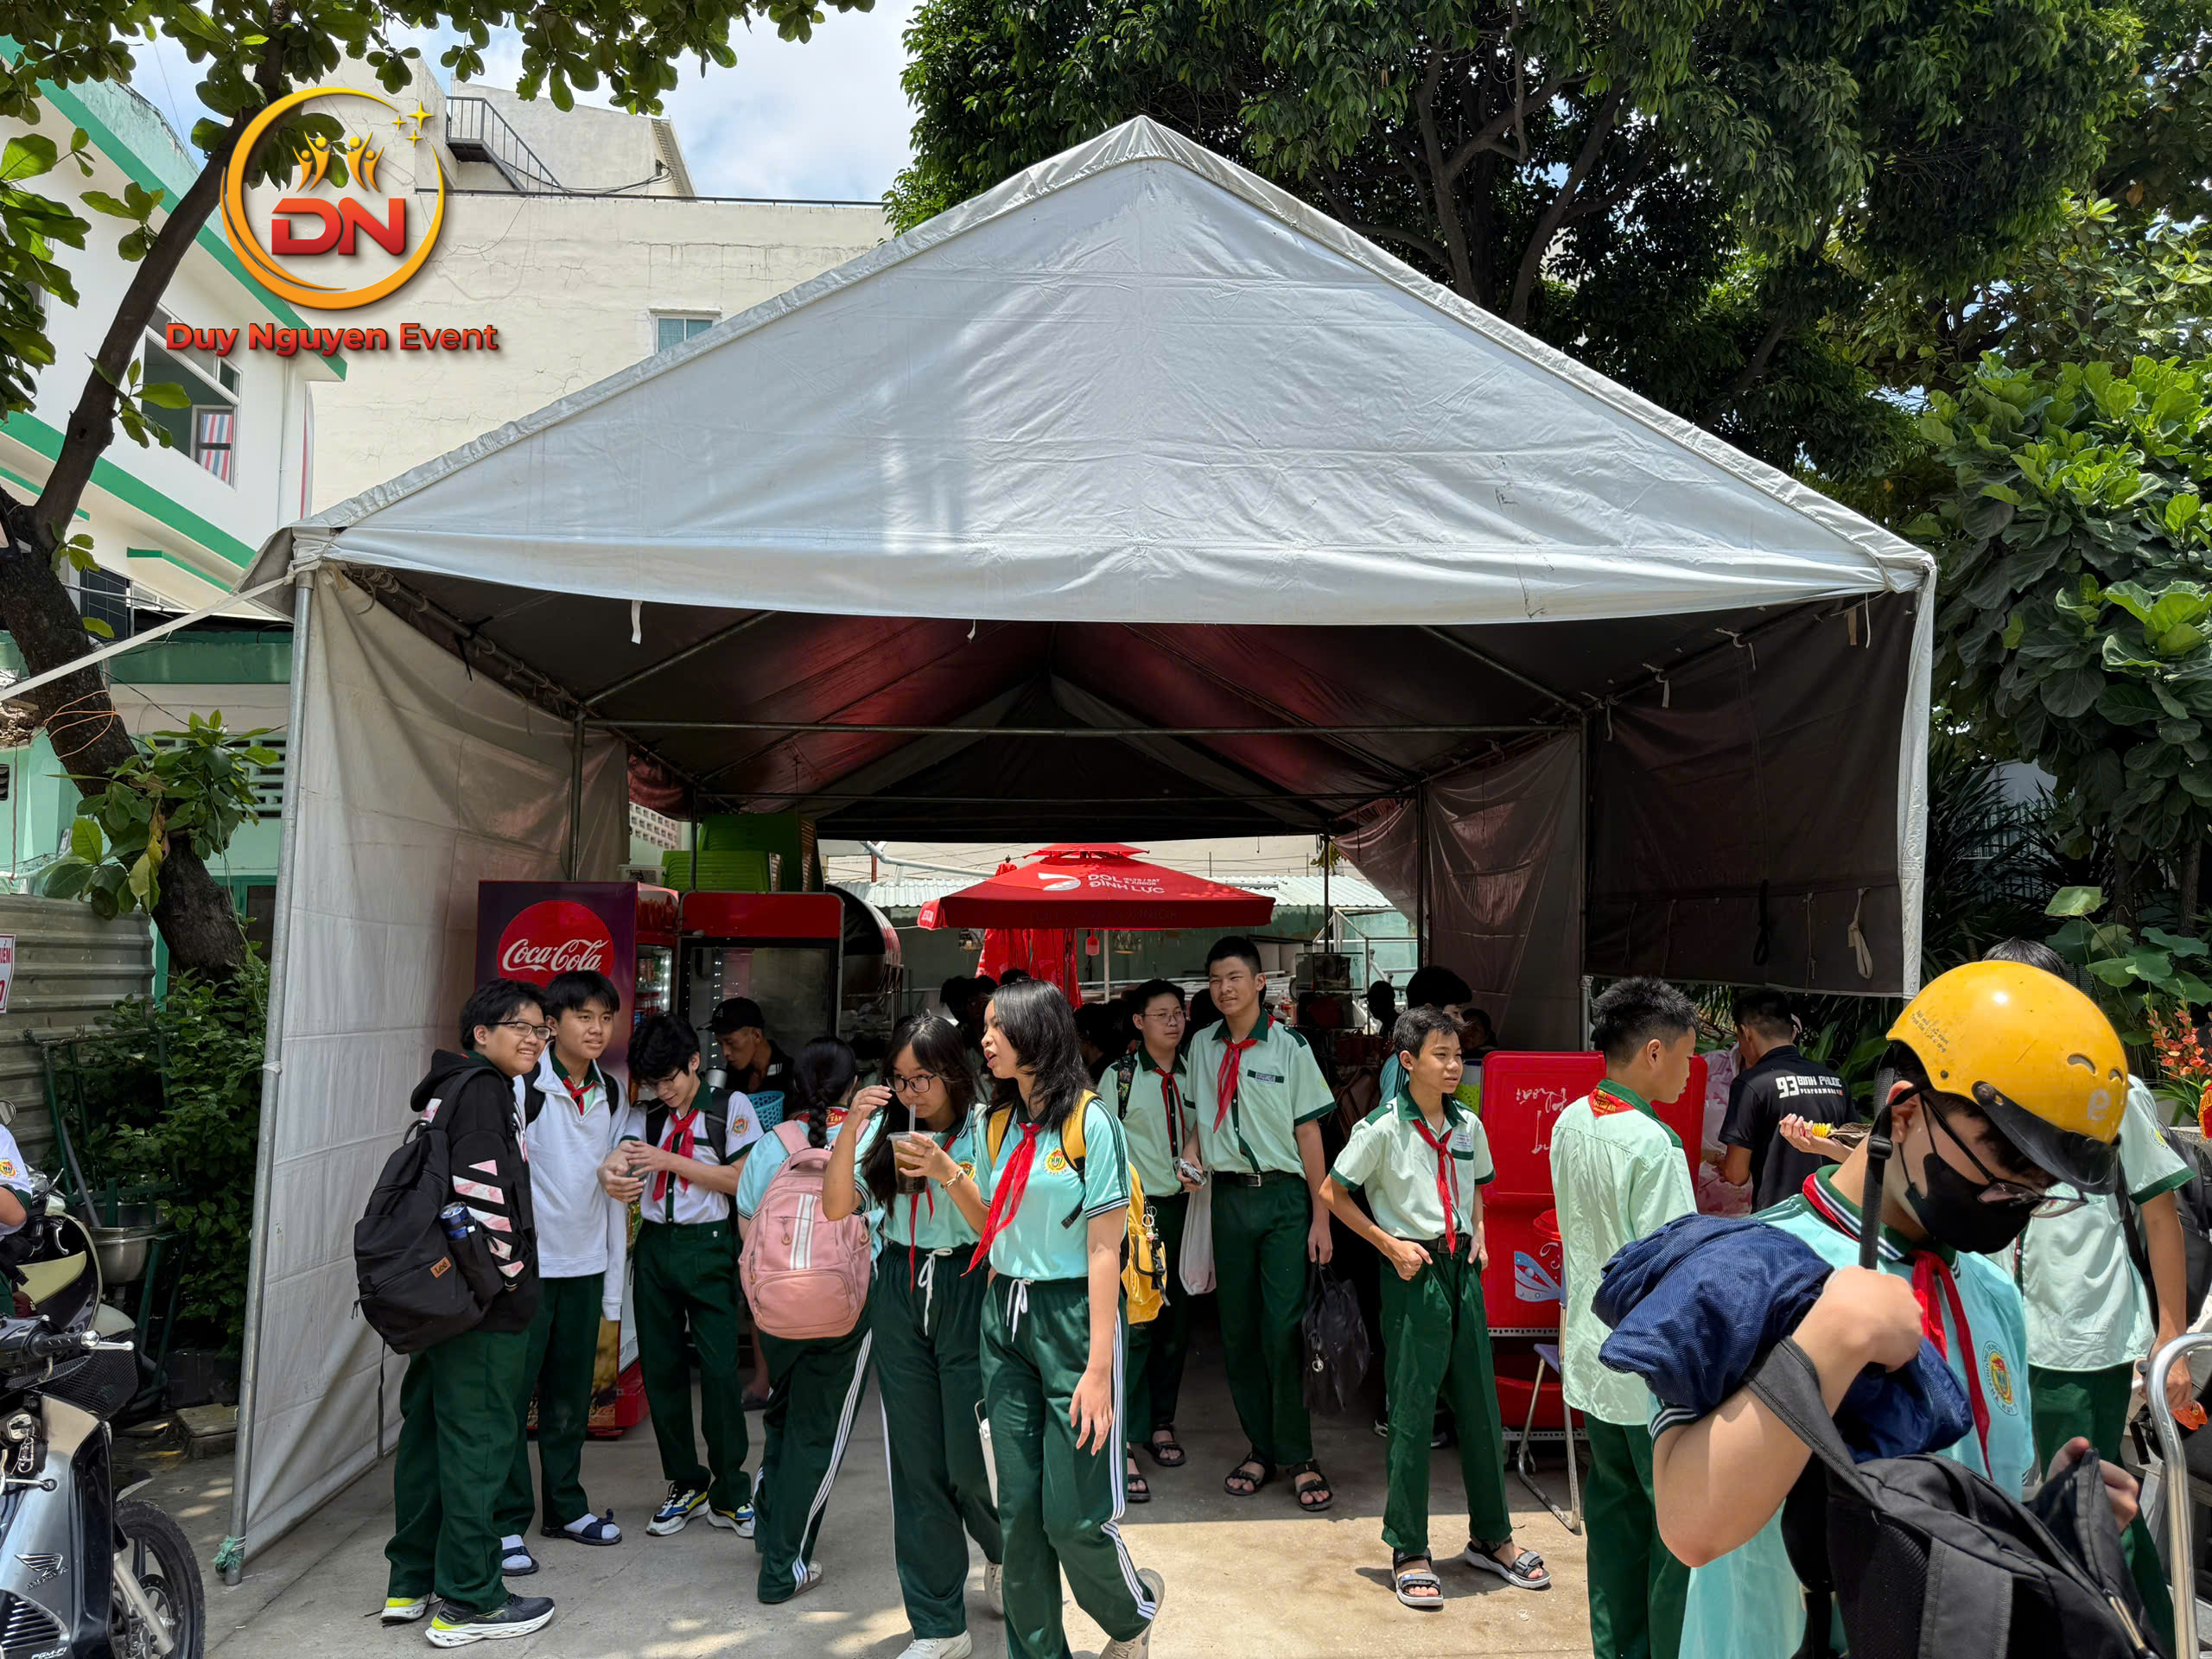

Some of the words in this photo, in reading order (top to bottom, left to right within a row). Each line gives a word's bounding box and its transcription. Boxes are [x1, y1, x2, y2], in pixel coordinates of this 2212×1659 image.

[1088, 874, 1122, 883] DOL
[502, 938, 609, 972] Coca-Cola
[1776, 1075, 1800, 1099] 93
[31, 1646, 68, 1659] PGM-FI
